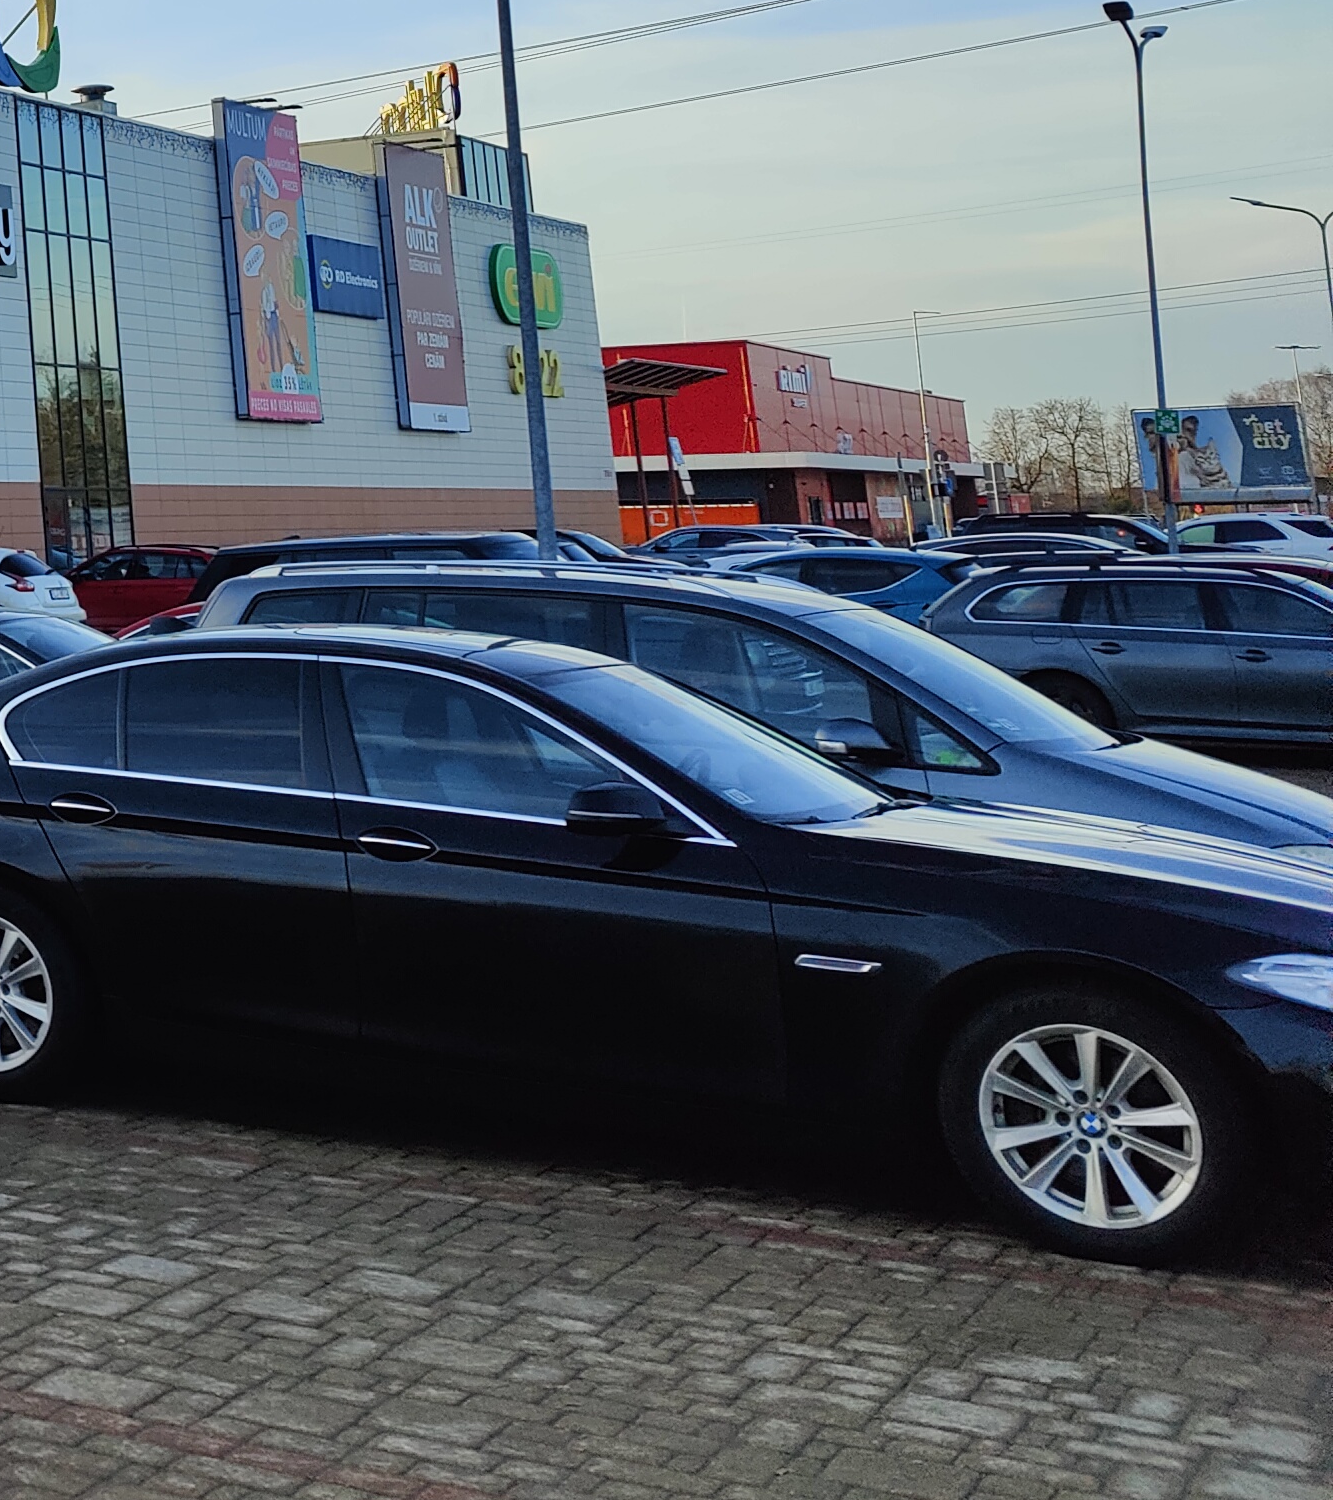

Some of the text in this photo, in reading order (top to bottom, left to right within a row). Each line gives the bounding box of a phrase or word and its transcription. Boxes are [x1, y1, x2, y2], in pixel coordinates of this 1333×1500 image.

[226, 107, 267, 141] MULTUM
[405, 226, 439, 253] OUTLET
[335, 269, 345, 283] RD
[346, 273, 378, 289] Electronics
[506, 264, 557, 313] evi
[506, 345, 564, 398] 822
[1252, 418, 1284, 436] pet
[1252, 431, 1292, 450] city
